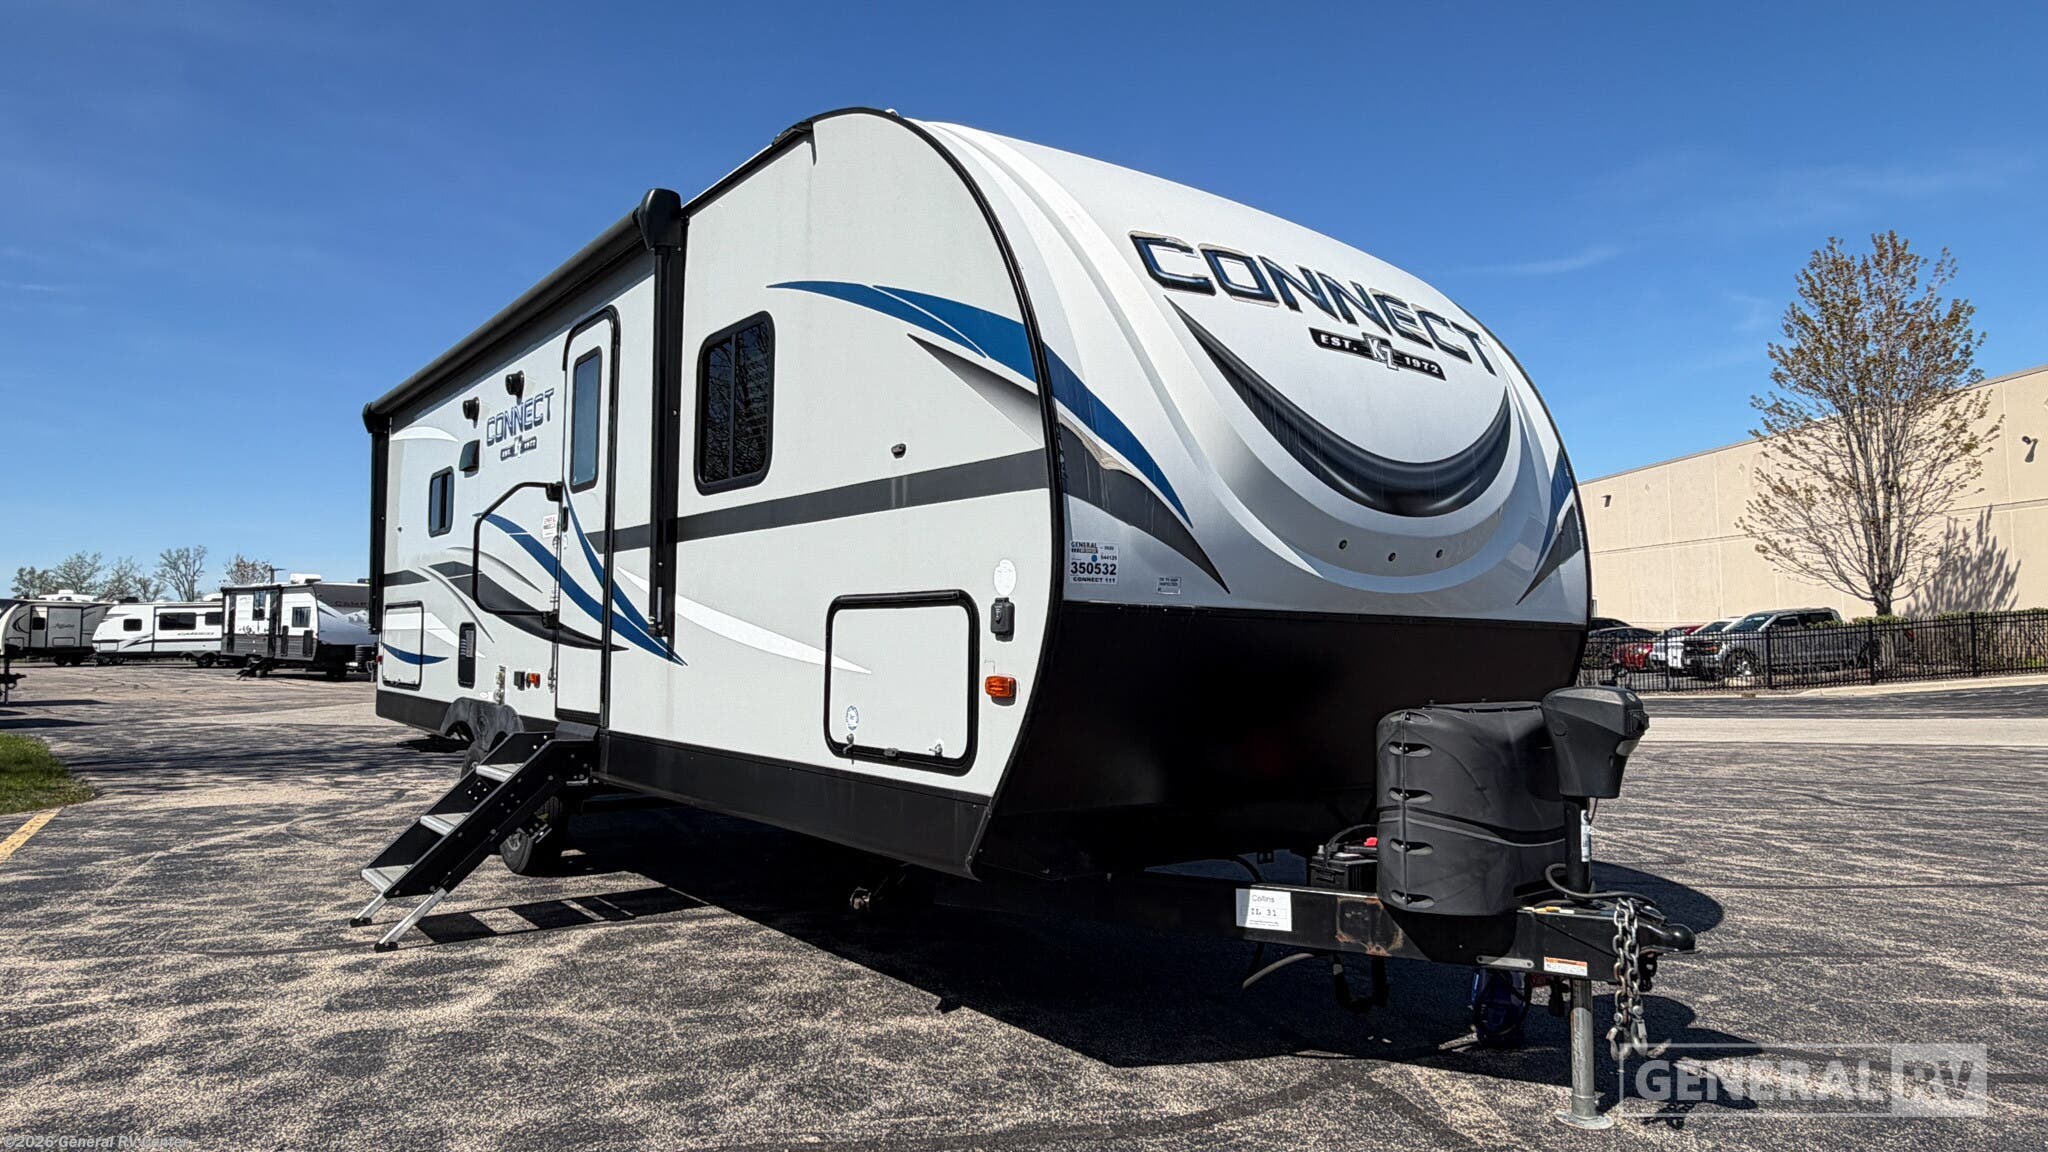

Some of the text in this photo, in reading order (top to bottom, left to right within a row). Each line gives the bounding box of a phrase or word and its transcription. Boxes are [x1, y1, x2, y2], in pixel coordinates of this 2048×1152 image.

[1128, 229, 1498, 377] CONNECT
[1320, 334, 1440, 374] EST. KZ 1972
[486, 387, 555, 447] CONNECT
[1070, 561, 1117, 576] 350532
